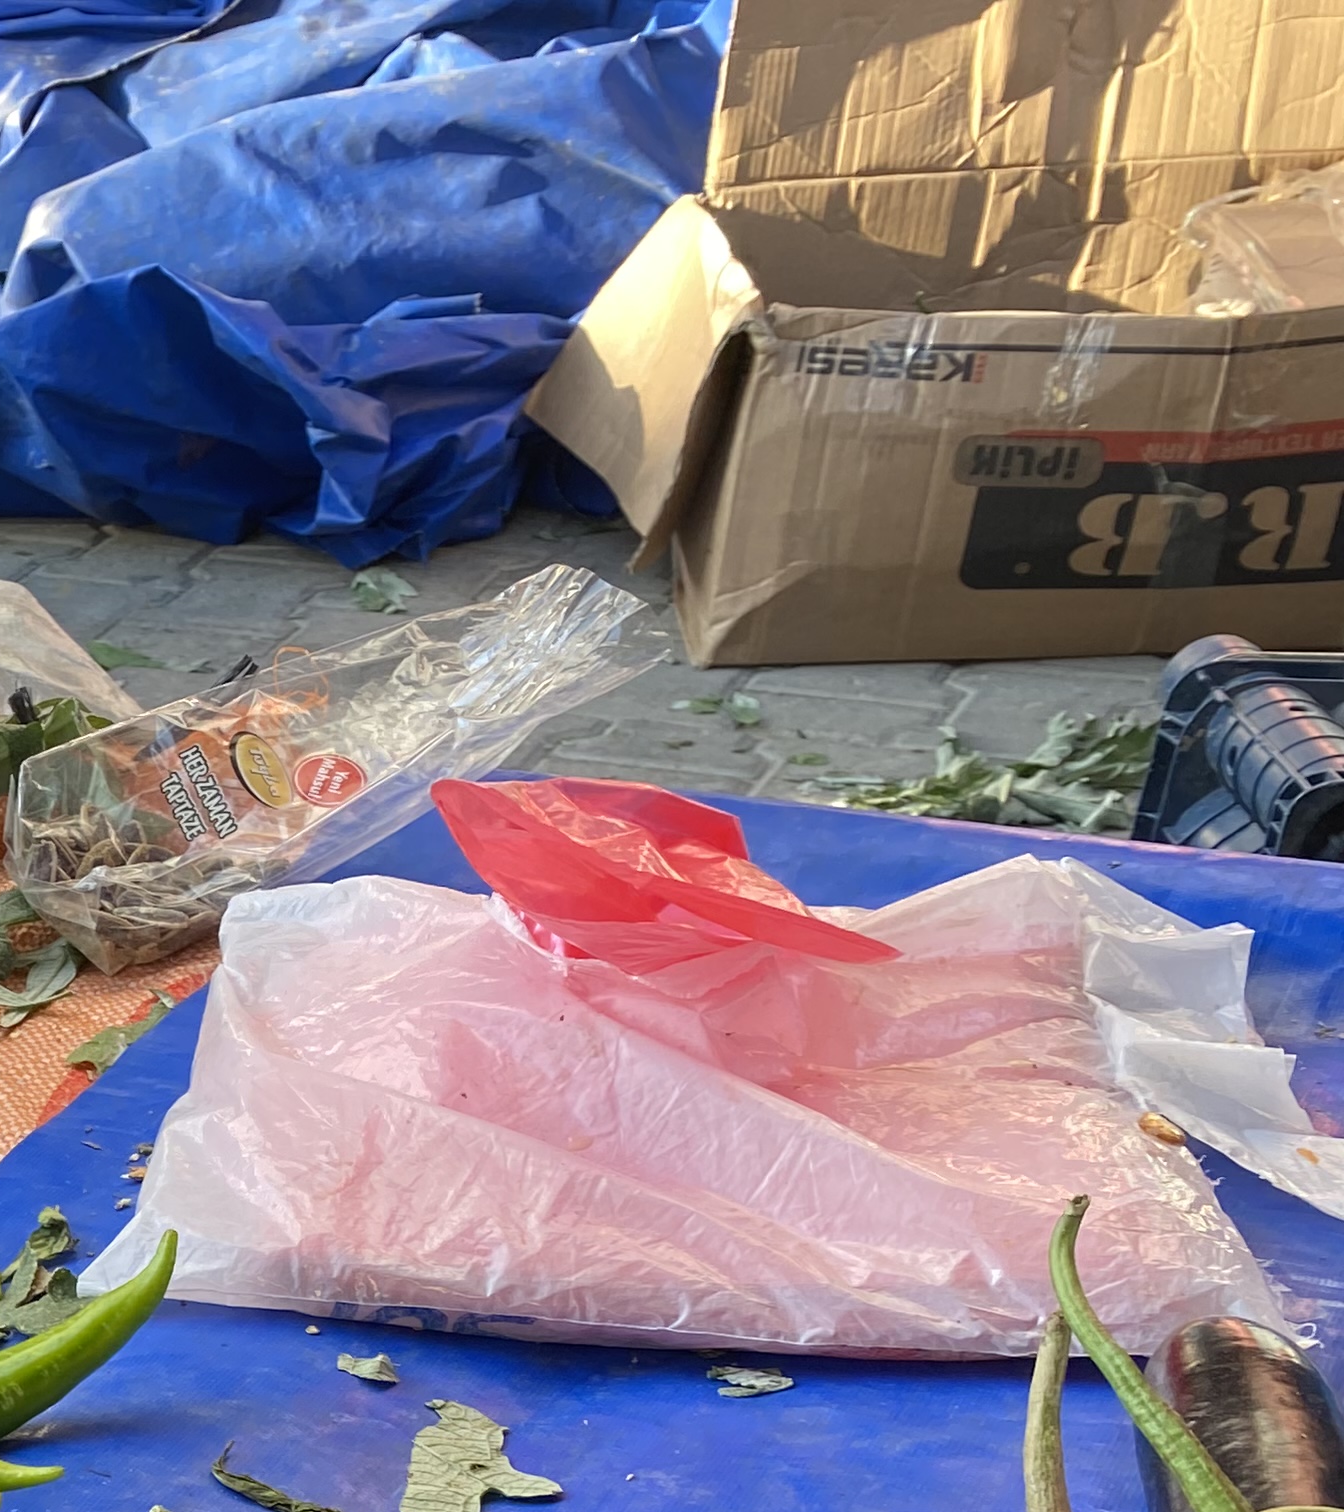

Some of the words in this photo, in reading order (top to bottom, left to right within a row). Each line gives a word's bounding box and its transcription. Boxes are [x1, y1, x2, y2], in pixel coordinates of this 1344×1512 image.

[160, 772, 206, 841] TAPTAZE
[180, 745, 210, 784] HER
[195, 774, 238, 838] ZAMAN
[308, 757, 336, 800] Mahsul
[327, 770, 350, 795] Yeni
